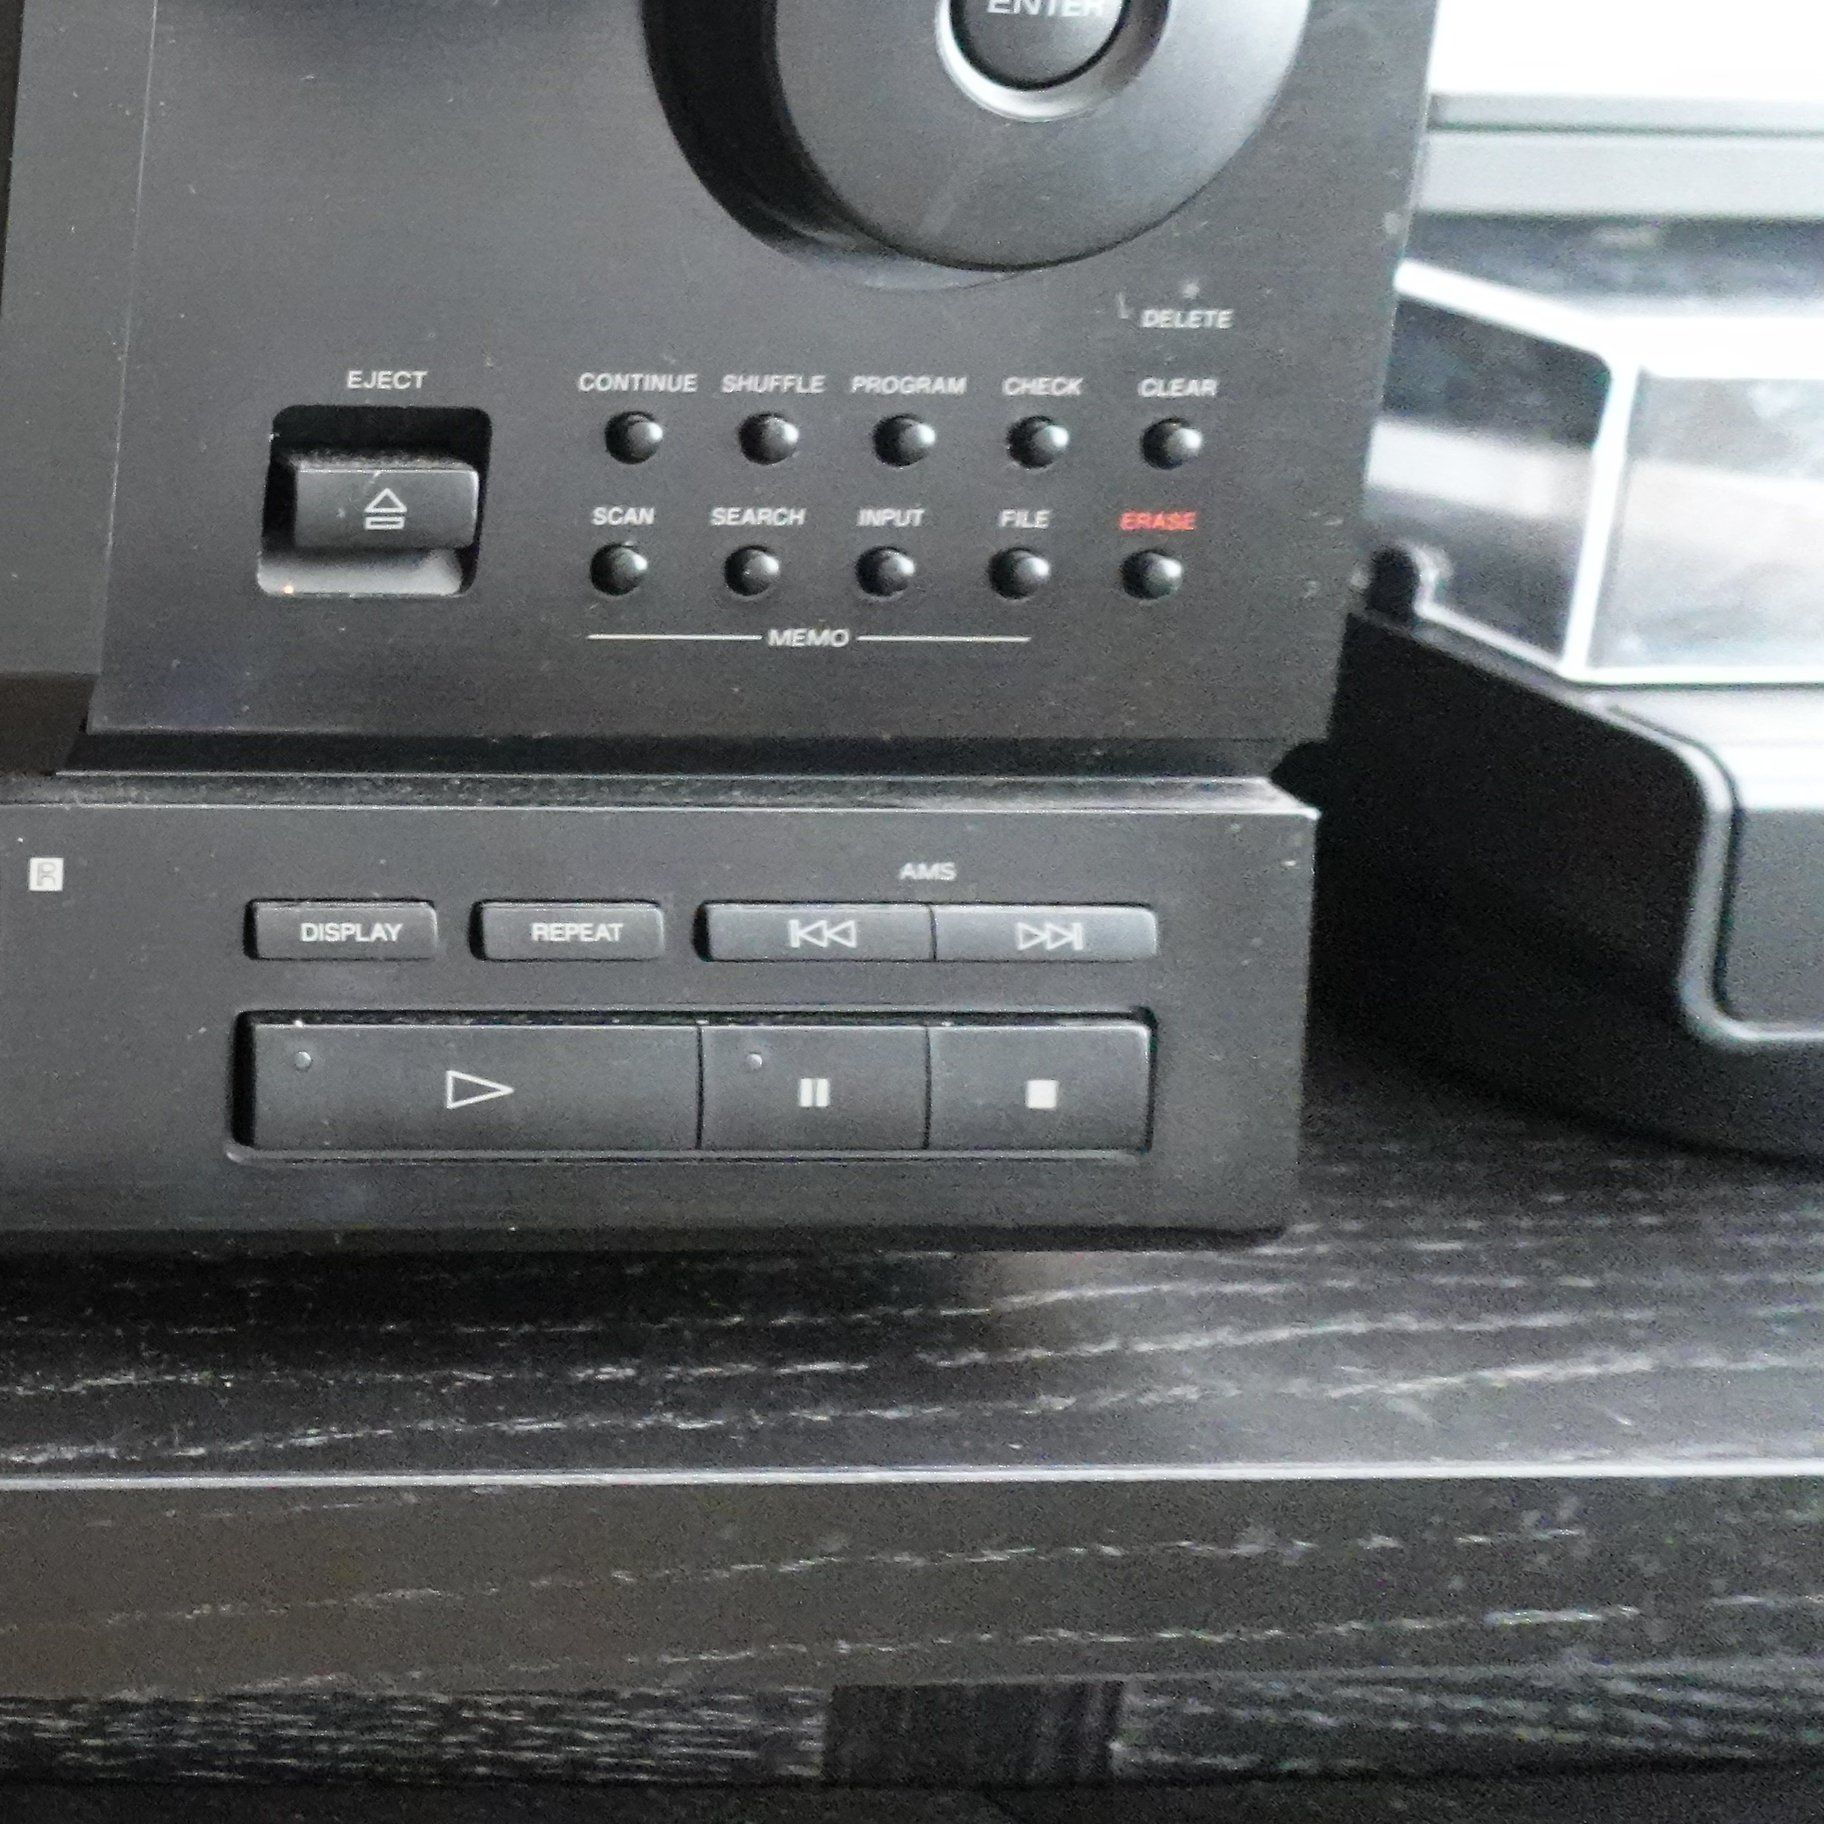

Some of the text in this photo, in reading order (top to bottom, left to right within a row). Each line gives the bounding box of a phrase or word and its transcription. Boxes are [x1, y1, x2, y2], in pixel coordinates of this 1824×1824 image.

[1142, 308, 1233, 330] DELETE
[346, 370, 427, 390] EJECT
[578, 372, 697, 394] CONTINUE
[722, 374, 825, 394] SHUFFLE
[851, 374, 967, 397] PROGRAM
[1003, 376, 1082, 398] CHECK
[1138, 376, 1217, 399] CLEAR
[592, 506, 654, 527] SCAN
[711, 507, 805, 528] SEARCH
[857, 508, 924, 528] INPUT
[999, 509, 1050, 529] FILE
[1120, 510, 1195, 532] ERASE
[767, 627, 849, 649] MEMO
[899, 862, 955, 880] AMS
[300, 922, 403, 944] DISPLAY
[530, 922, 623, 944] REPEAT
